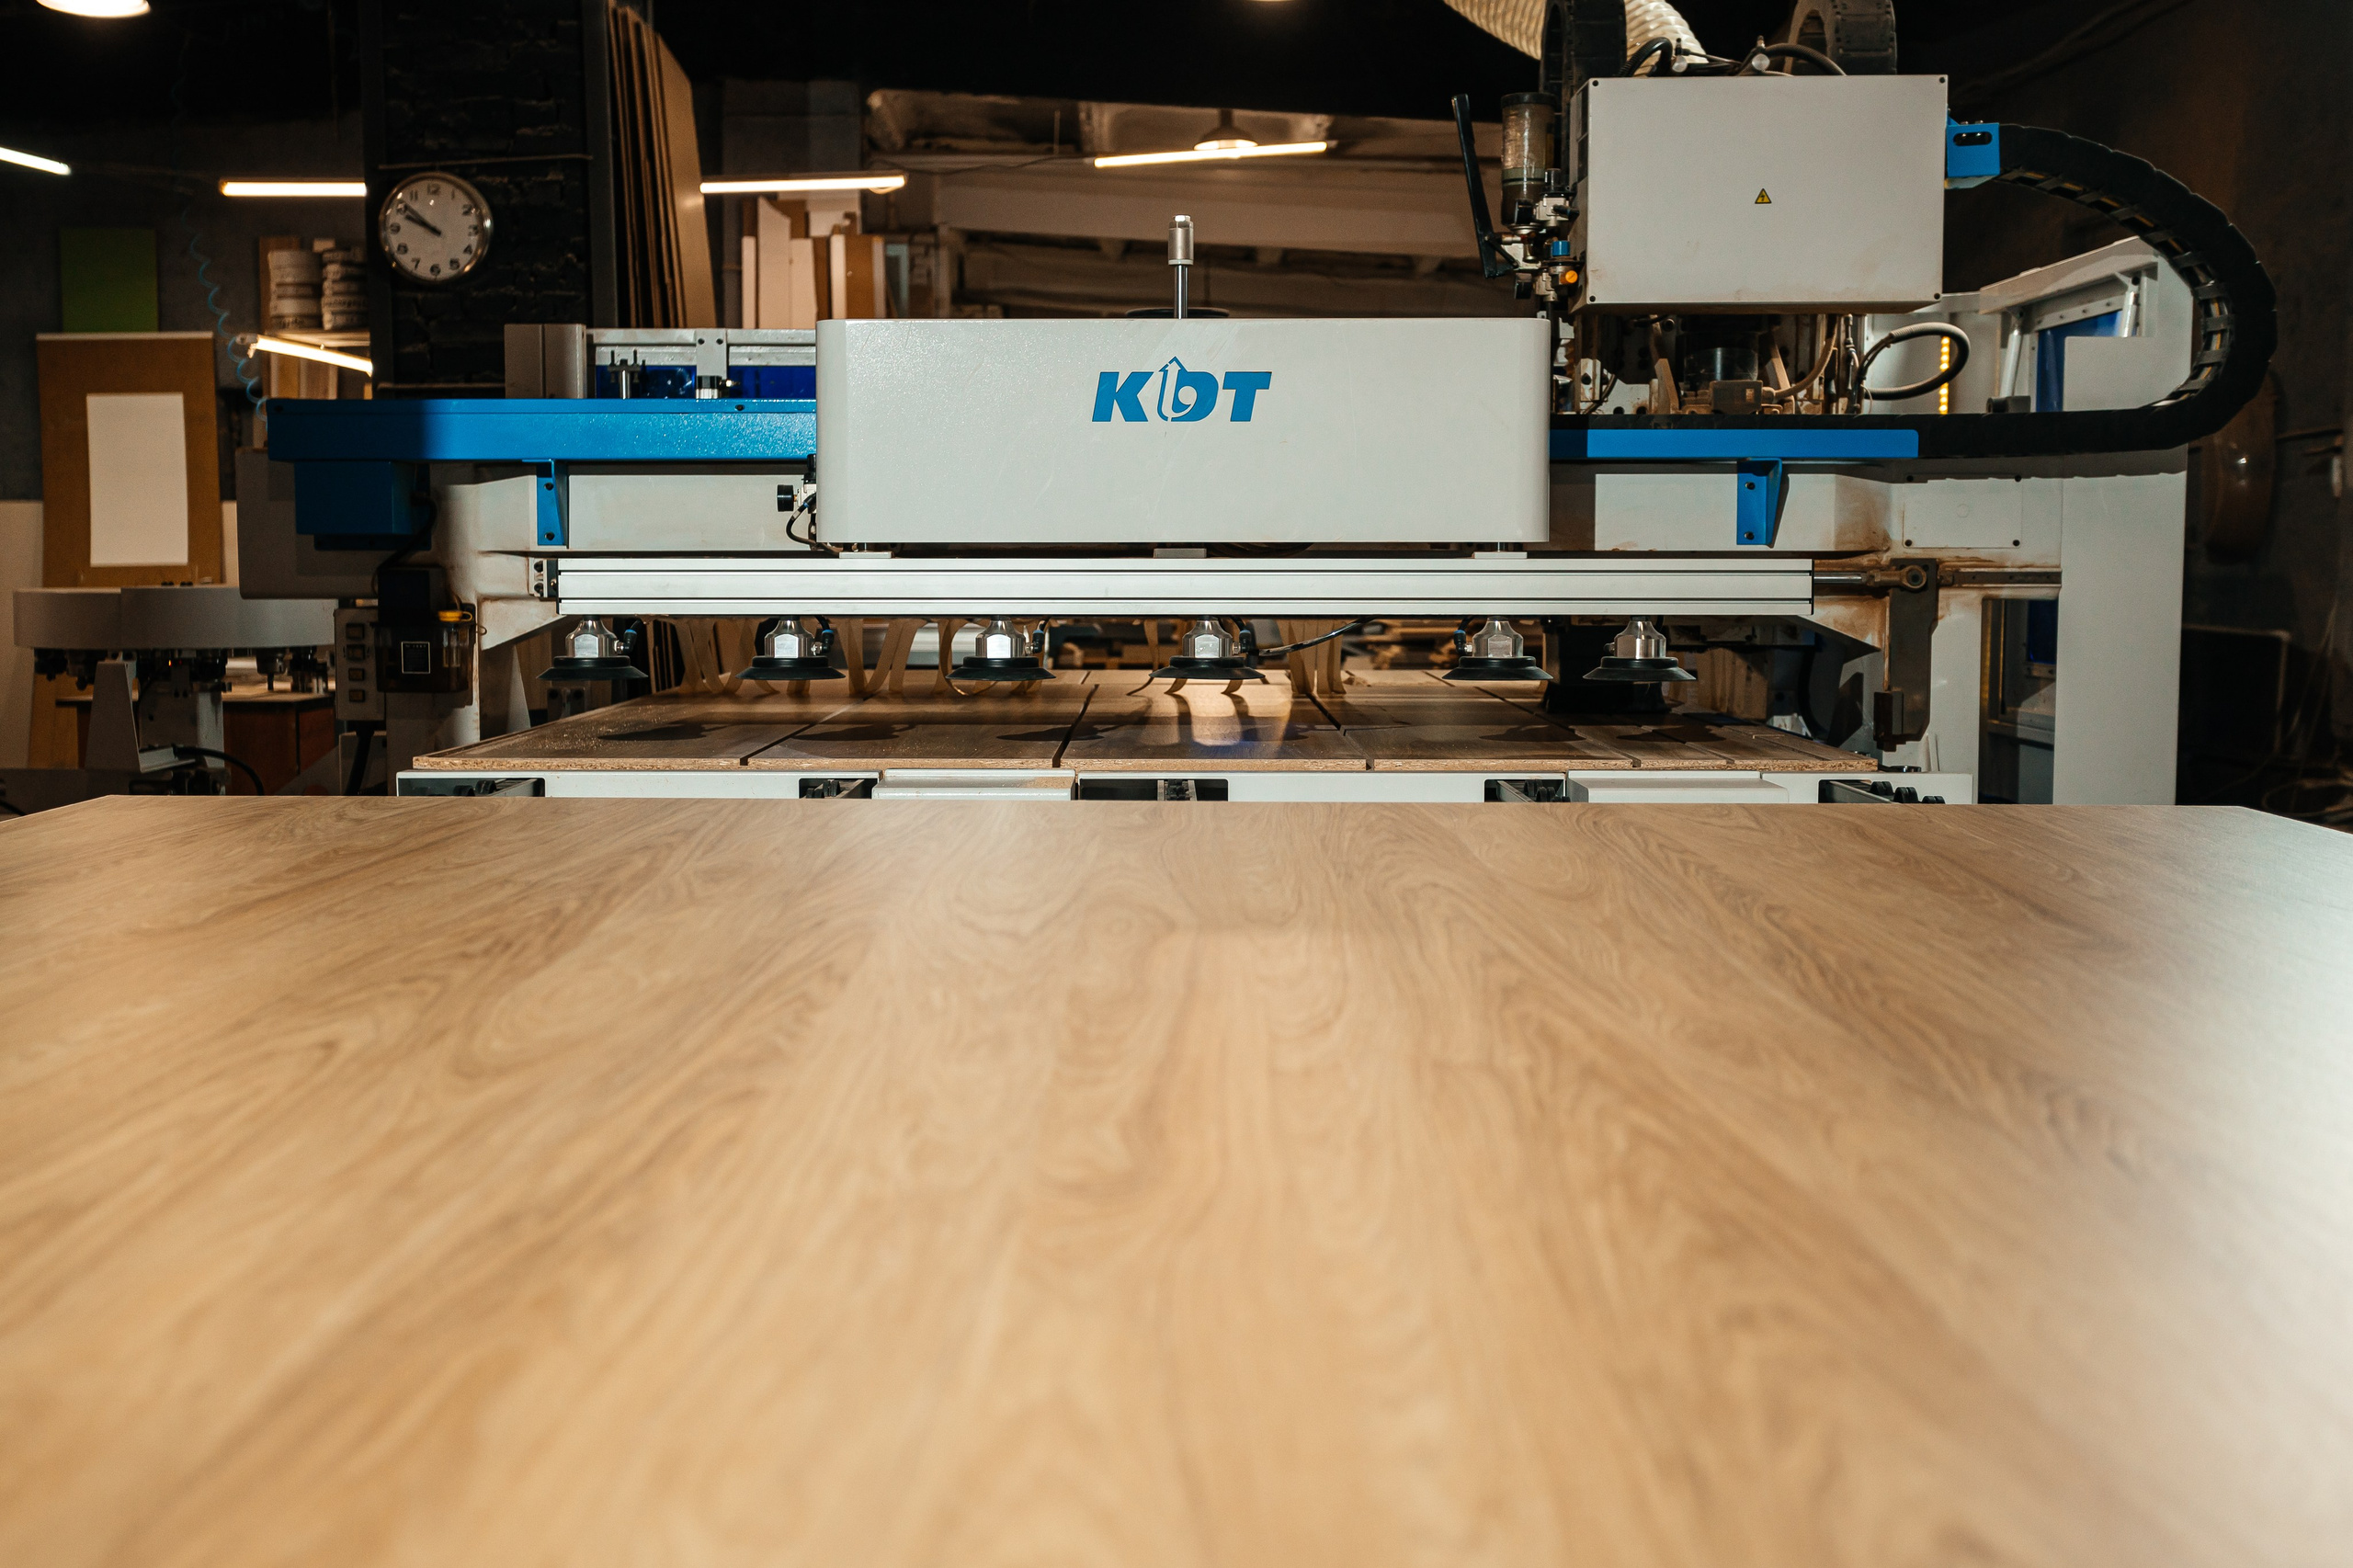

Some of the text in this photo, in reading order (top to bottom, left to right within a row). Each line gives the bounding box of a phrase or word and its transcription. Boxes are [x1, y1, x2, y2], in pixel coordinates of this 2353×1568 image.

[427, 184, 440, 196] 12
[451, 189, 456, 200] 1
[463, 244, 473, 256] 4
[411, 257, 421, 270] 7
[1092, 357, 1272, 422] KDT
